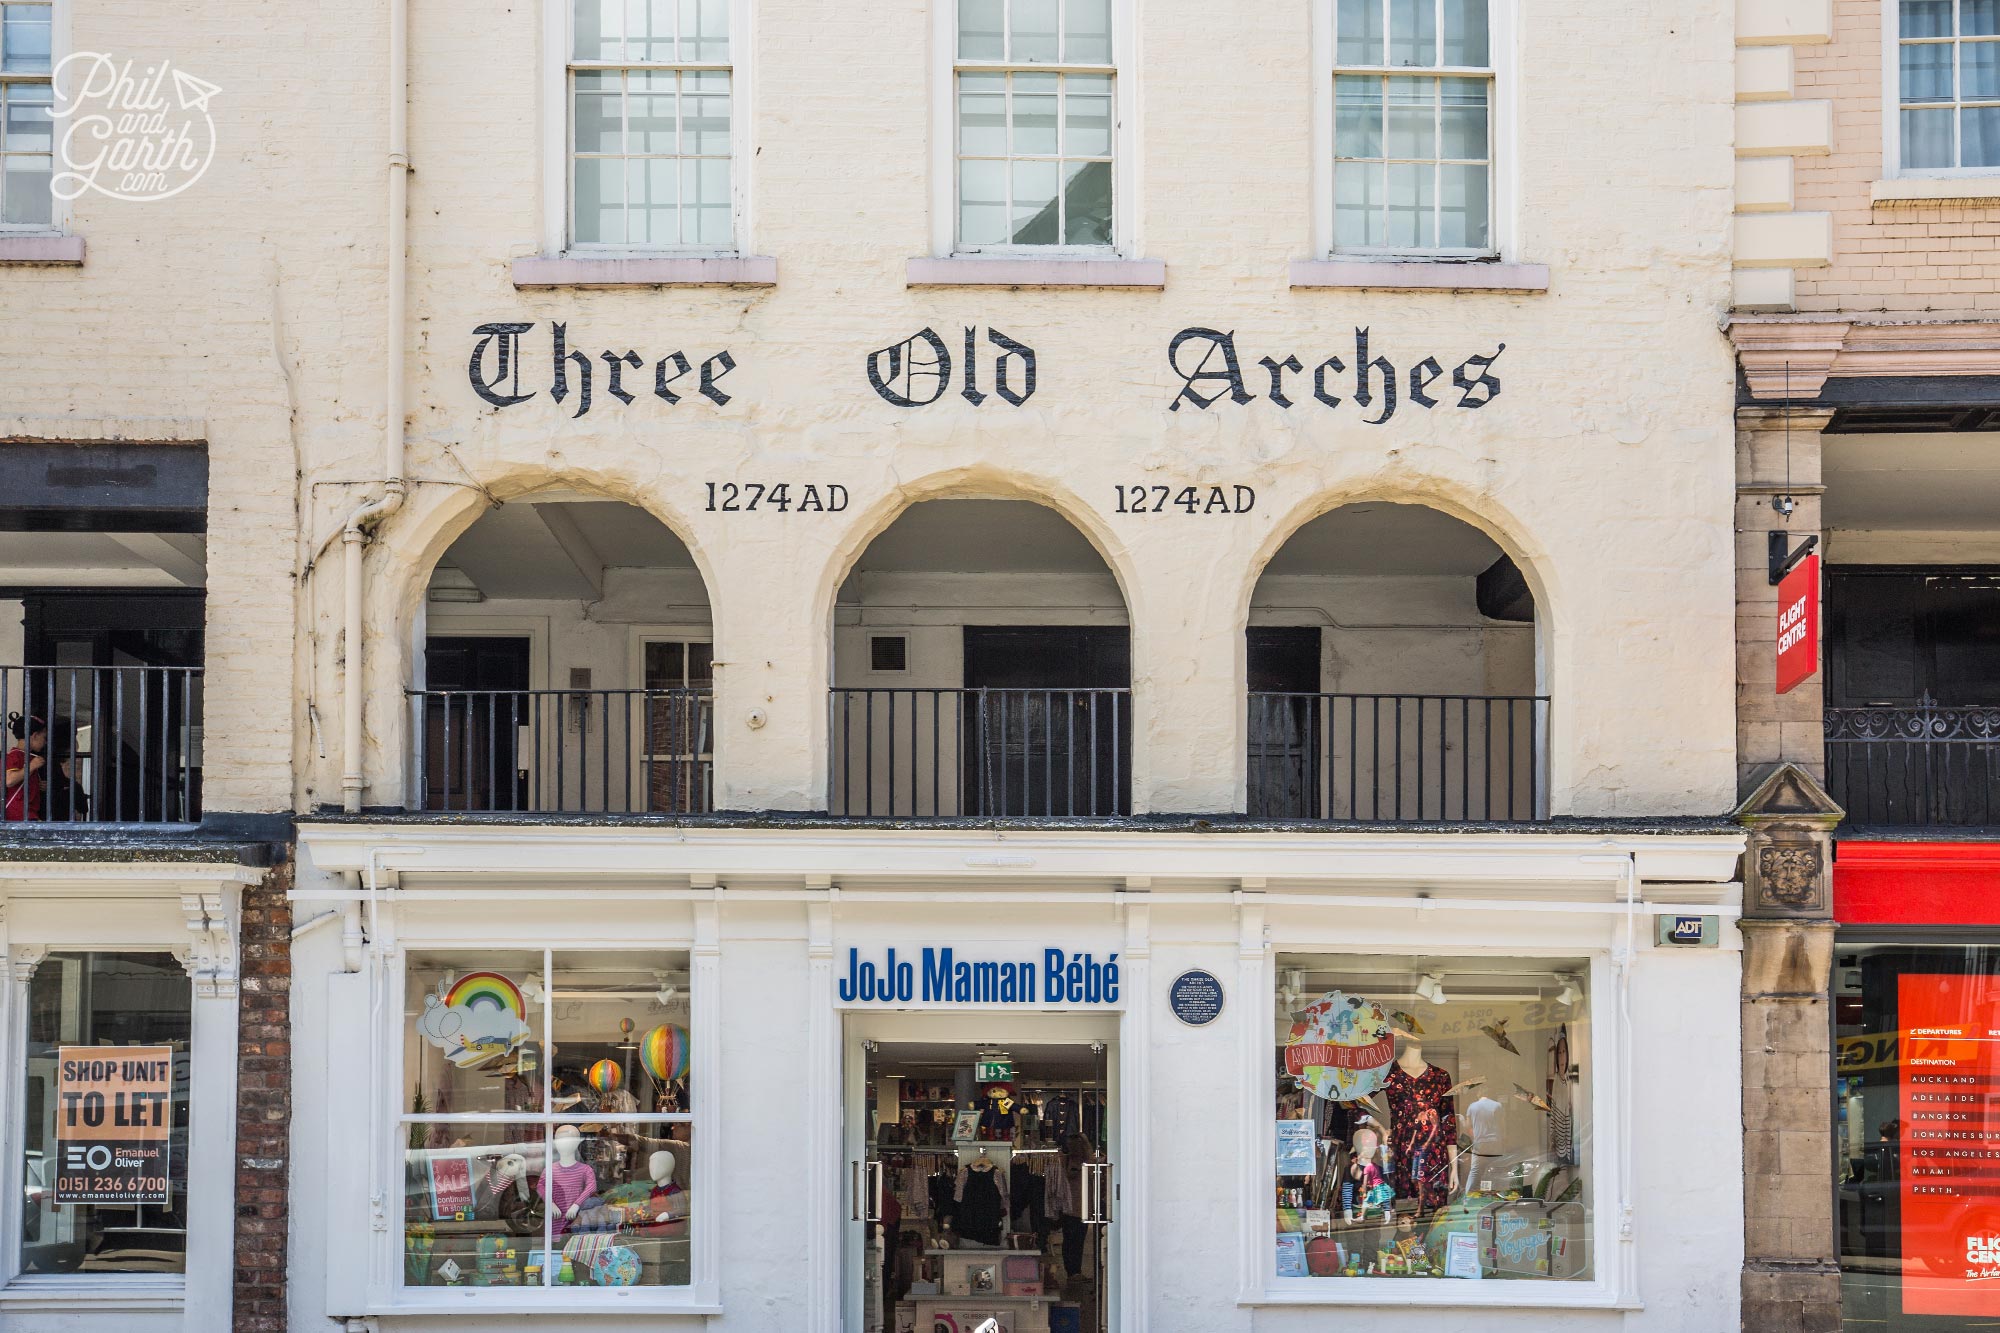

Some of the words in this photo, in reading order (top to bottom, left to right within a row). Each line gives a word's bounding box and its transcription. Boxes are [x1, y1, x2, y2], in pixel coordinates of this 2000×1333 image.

[468, 321, 737, 418] Three
[867, 325, 1037, 408] Old
[1168, 325, 1506, 425] Arches
[1779, 595, 1806, 633] FLIGHT
[1778, 617, 1806, 655] CENTRE
[1675, 920, 1703, 934] ADT
[839, 947, 914, 1002] JoJo
[922, 947, 1036, 1003] Maman
[1044, 948, 1119, 1004] Bébé
[1291, 1045, 1333, 1067] AROUND
[1337, 1047, 1351, 1067] THE
[1355, 1044, 1392, 1068] WORLD
[64, 1060, 117, 1082] SHOP
[122, 1060, 168, 1082] UNIT
[63, 1091, 105, 1127] TO
[114, 1091, 168, 1127] LET
[1912, 1094, 1974, 1102] ADELAIDE
[115, 1148, 160, 1158] Emanuel
[115, 1157, 145, 1168] Oliver
[58, 1177, 89, 1191] 0151
[94, 1177, 123, 1191] 236
[127, 1177, 166, 1191] 6700
[435, 1173, 469, 1195] SALE
[1914, 1186, 1952, 1194] PERTH
[438, 1196, 471, 1204] continues
[1497, 1212, 1529, 1236] Bon
[1495, 1233, 1551, 1264] Voyage
[1966, 1269, 1978, 1278] The
